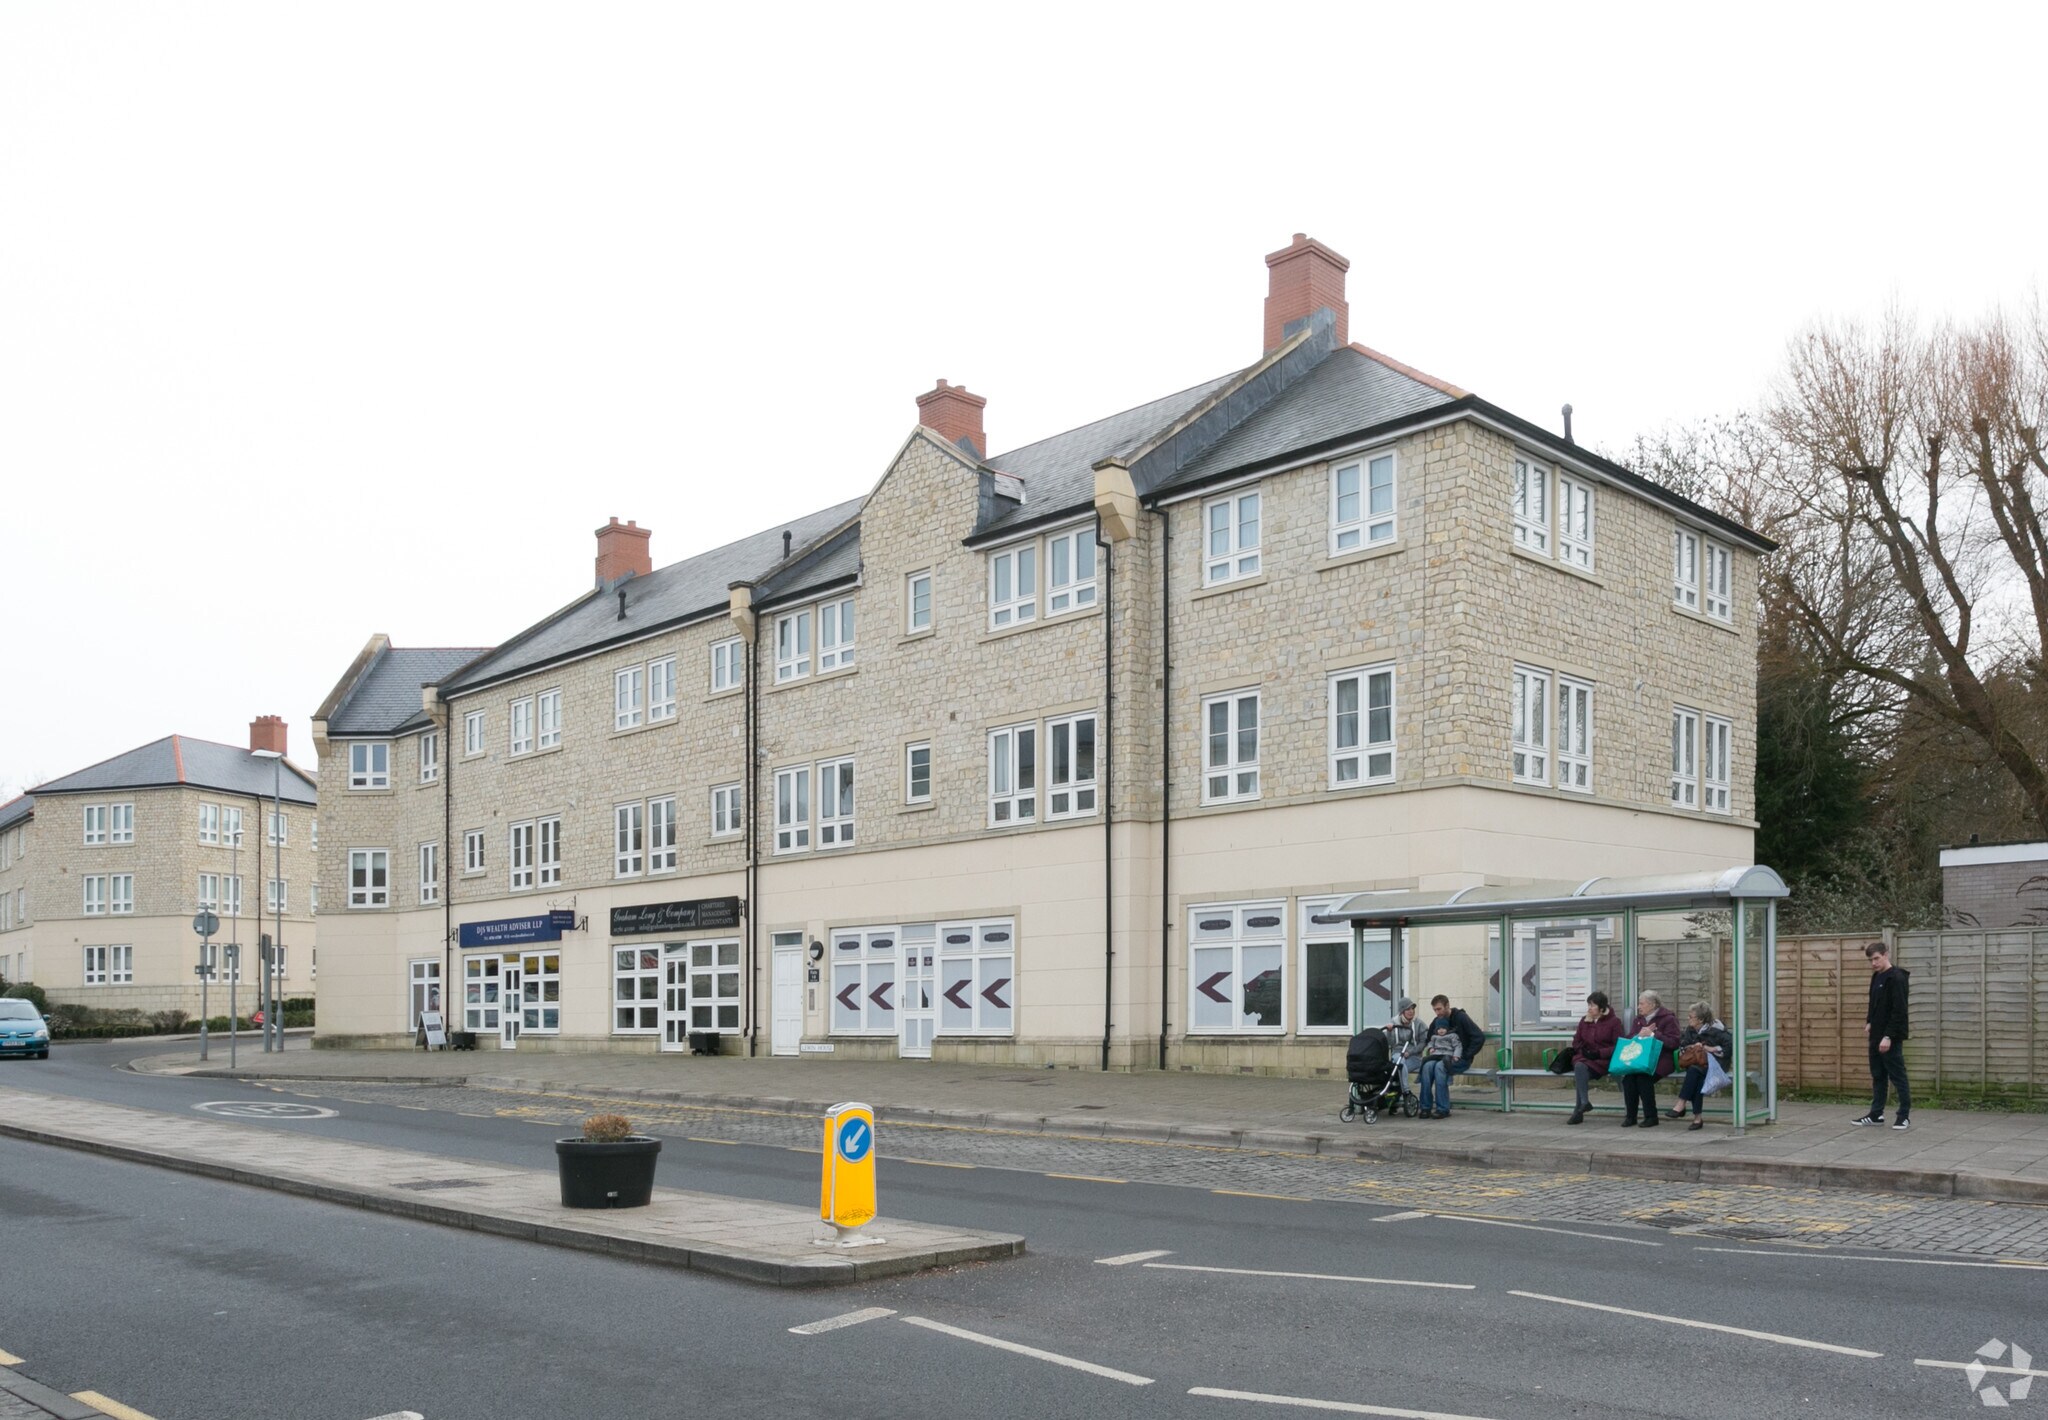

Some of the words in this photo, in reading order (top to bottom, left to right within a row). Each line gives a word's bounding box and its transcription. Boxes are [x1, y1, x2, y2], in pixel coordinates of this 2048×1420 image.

[614, 909, 637, 921] Graham
[638, 906, 656, 924] Long
[657, 907, 665, 924] &
[666, 904, 696, 922] Company
[702, 909, 731, 918] MANAGEMENT
[476, 926, 486, 935] DJS
[486, 923, 508, 932] WEALTH
[508, 921, 532, 931] ADVISER
[532, 920, 543, 929] LLP
[702, 917, 734, 926] ACCOUNTANTS
